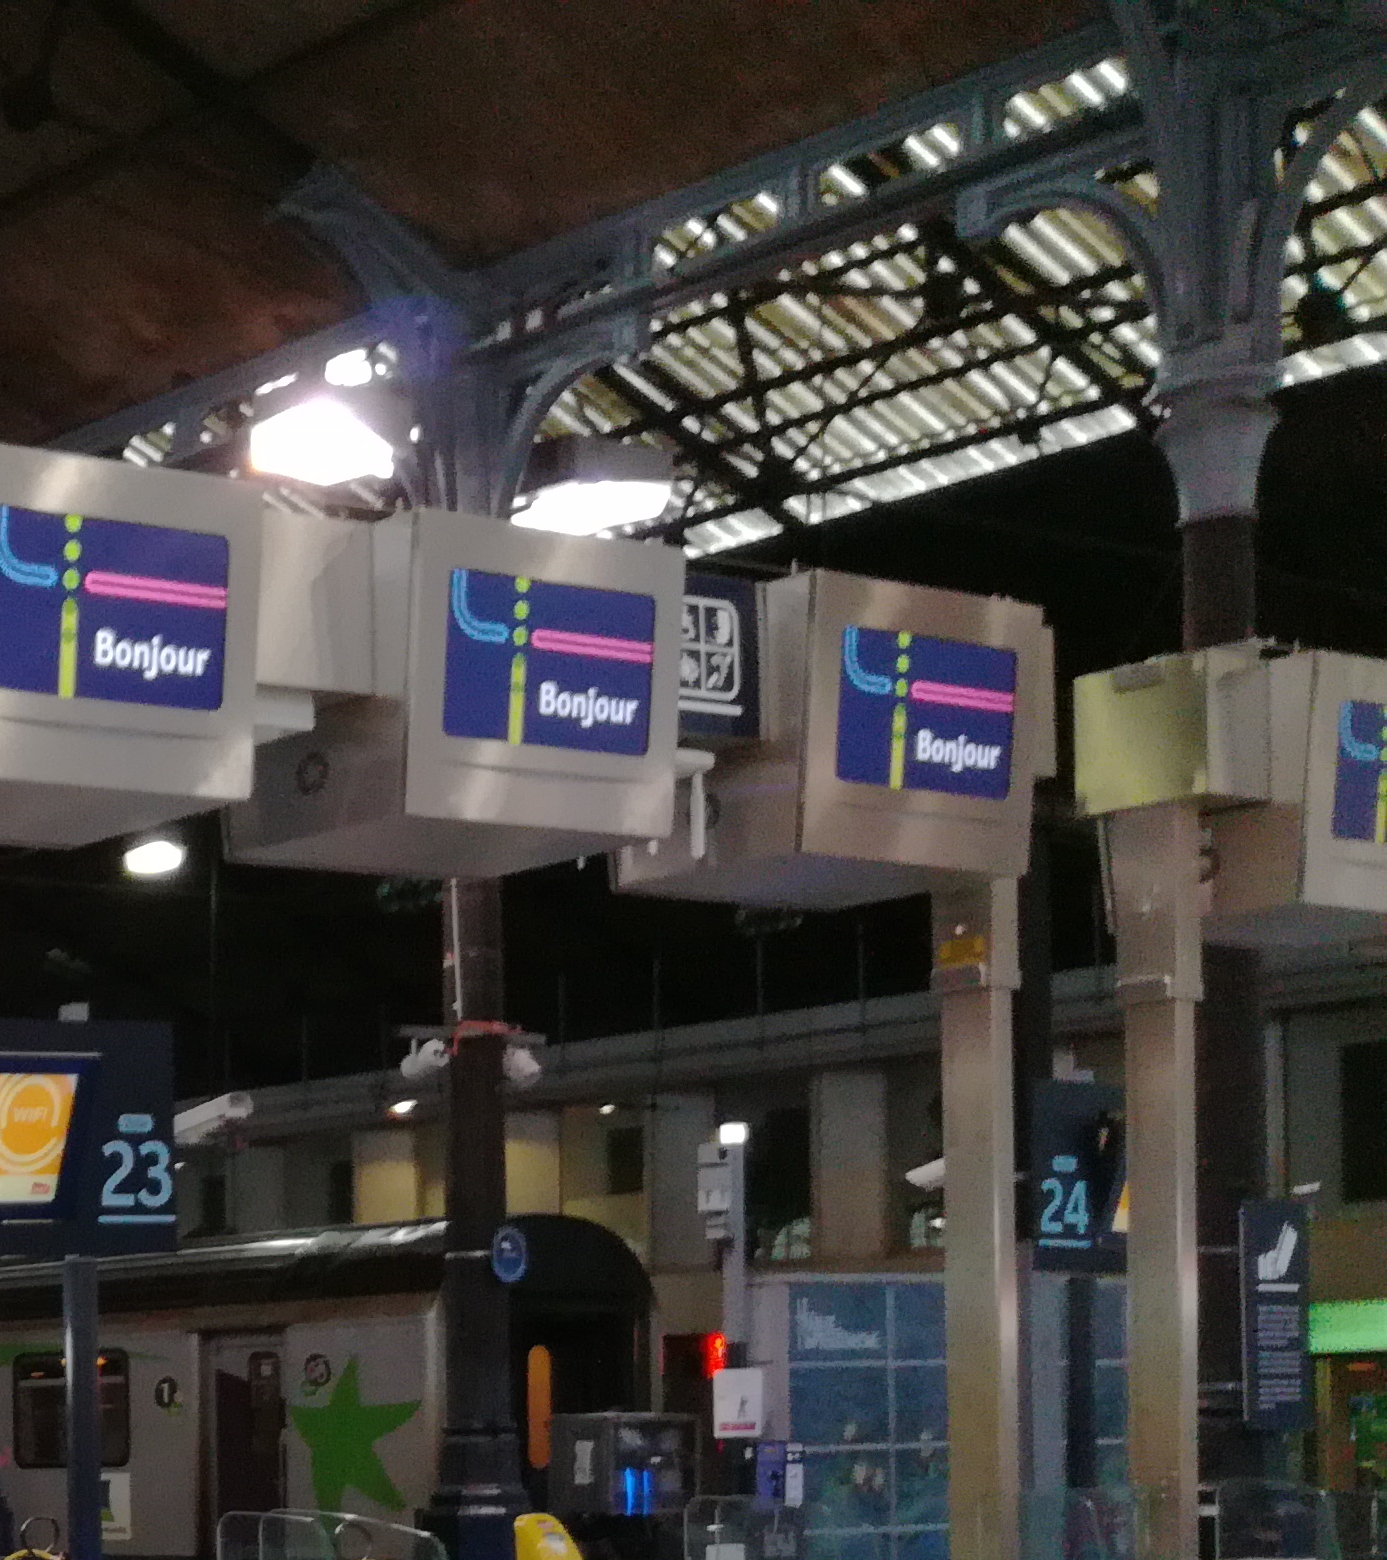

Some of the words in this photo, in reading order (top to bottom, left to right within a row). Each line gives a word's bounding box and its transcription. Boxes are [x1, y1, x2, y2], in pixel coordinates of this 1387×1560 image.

[94, 629, 211, 680] Bonjour
[539, 681, 638, 728] Bonjour
[915, 728, 1001, 772] Bonjour
[101, 1140, 172, 1208] 23
[1041, 1178, 1089, 1235] 24
[161, 1382, 170, 1403] 1
